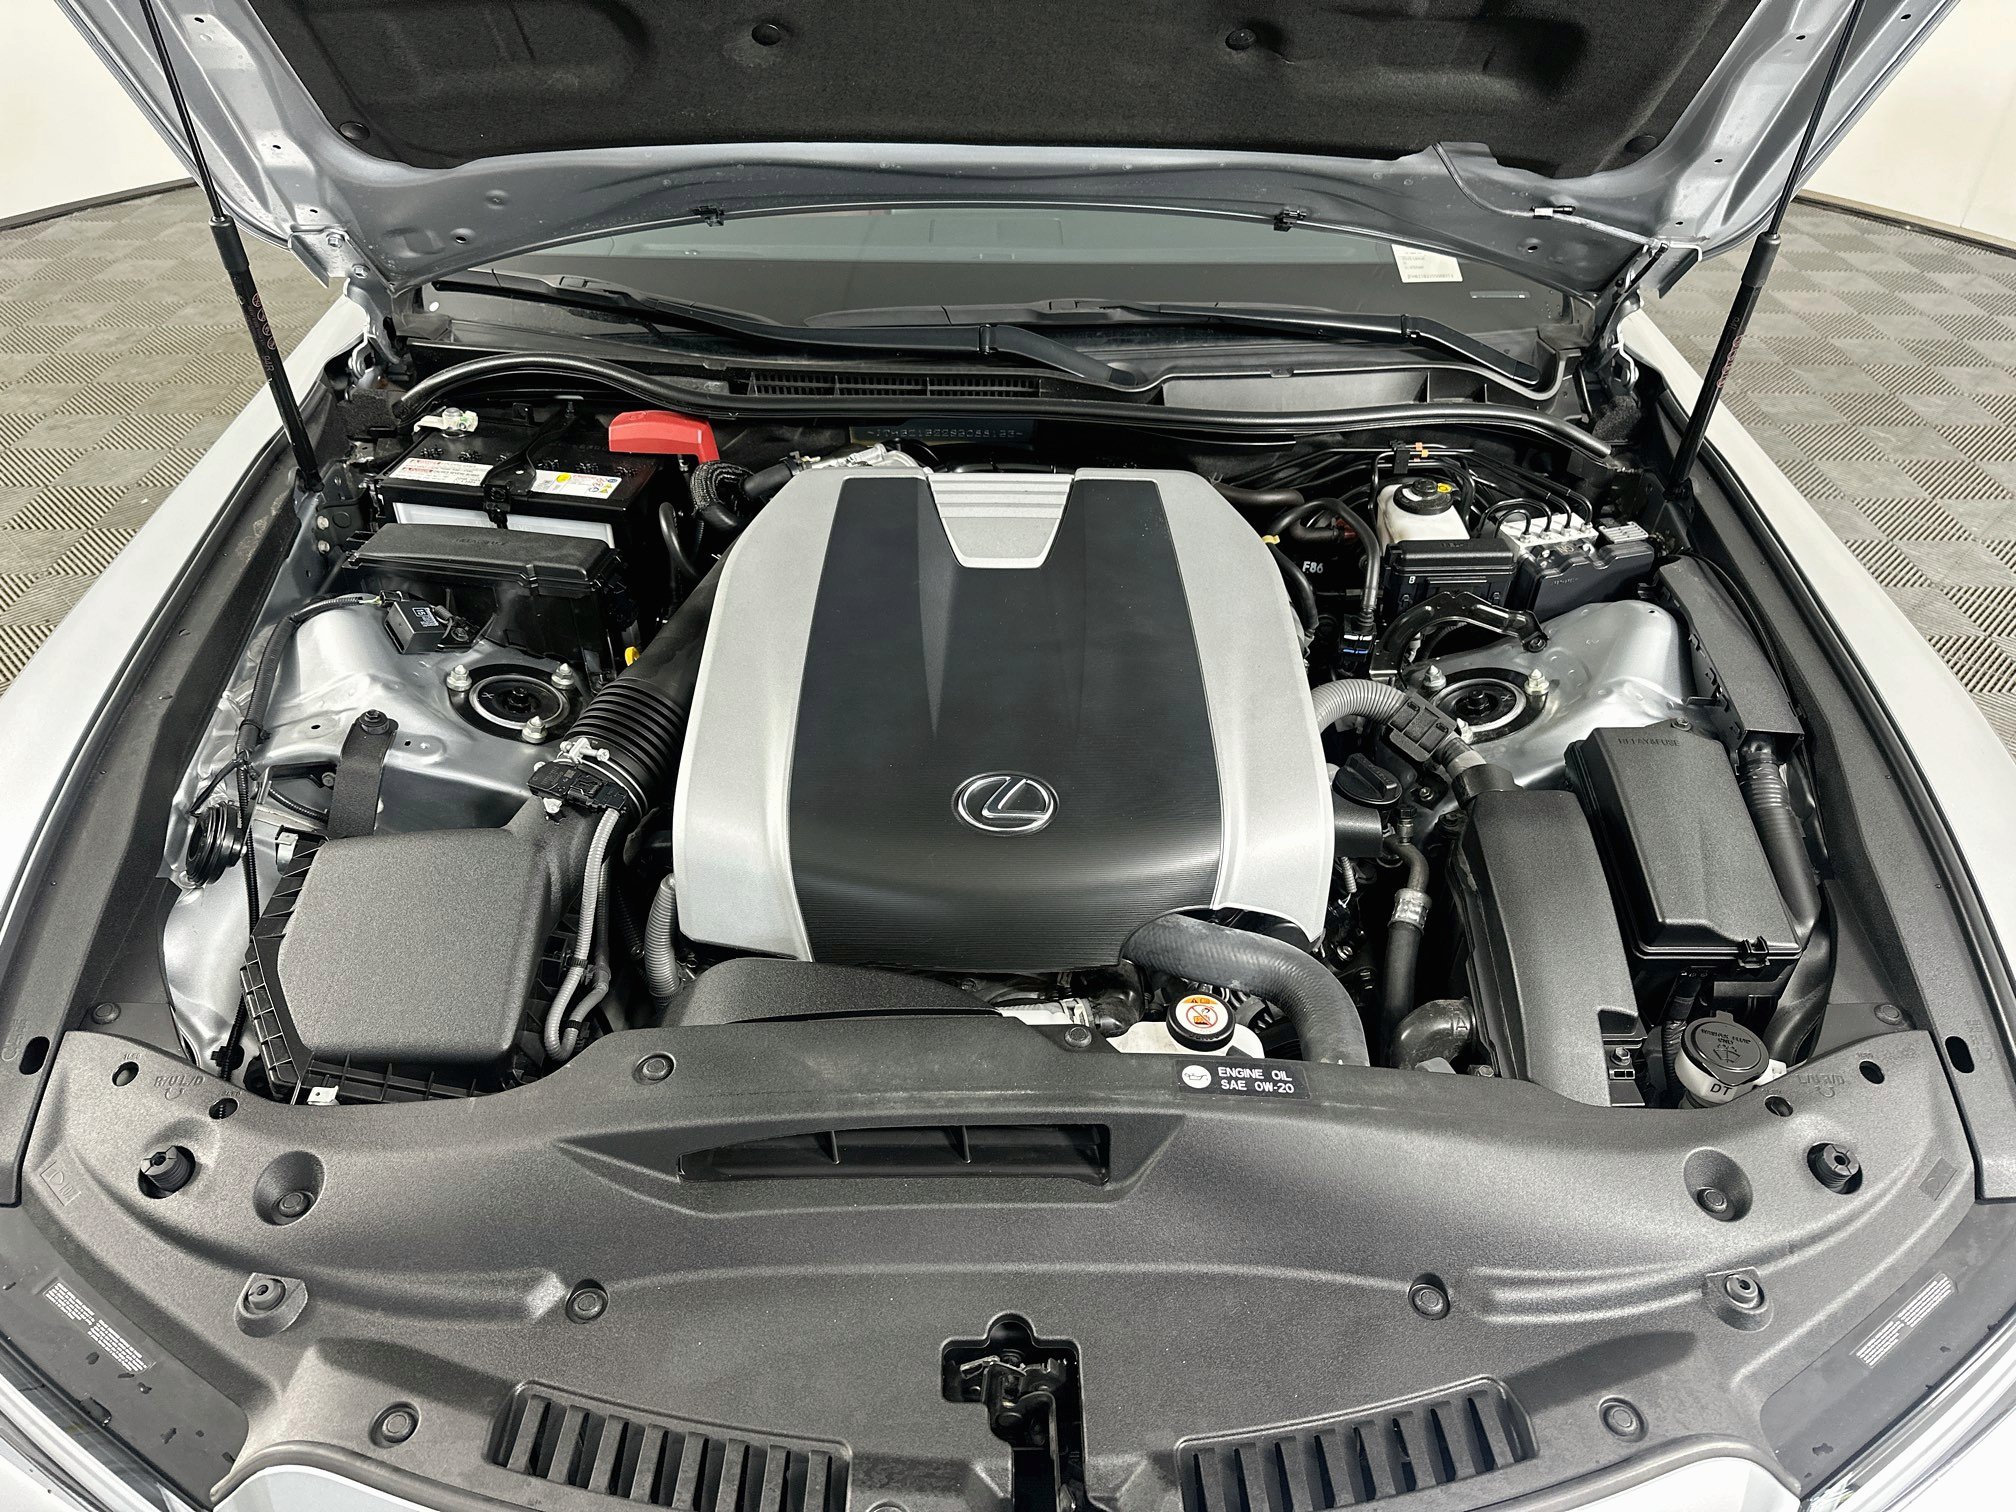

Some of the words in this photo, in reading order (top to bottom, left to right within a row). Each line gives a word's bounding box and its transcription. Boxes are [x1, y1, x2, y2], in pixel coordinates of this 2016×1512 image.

[1302, 560, 1324, 574] F86
[1217, 1066, 1265, 1080] ENGINE
[1271, 1069, 1293, 1082] OIL
[1220, 1079, 1248, 1091] SAE
[1254, 1081, 1296, 1094] 0W-20
[1709, 1083, 1733, 1096] DT
